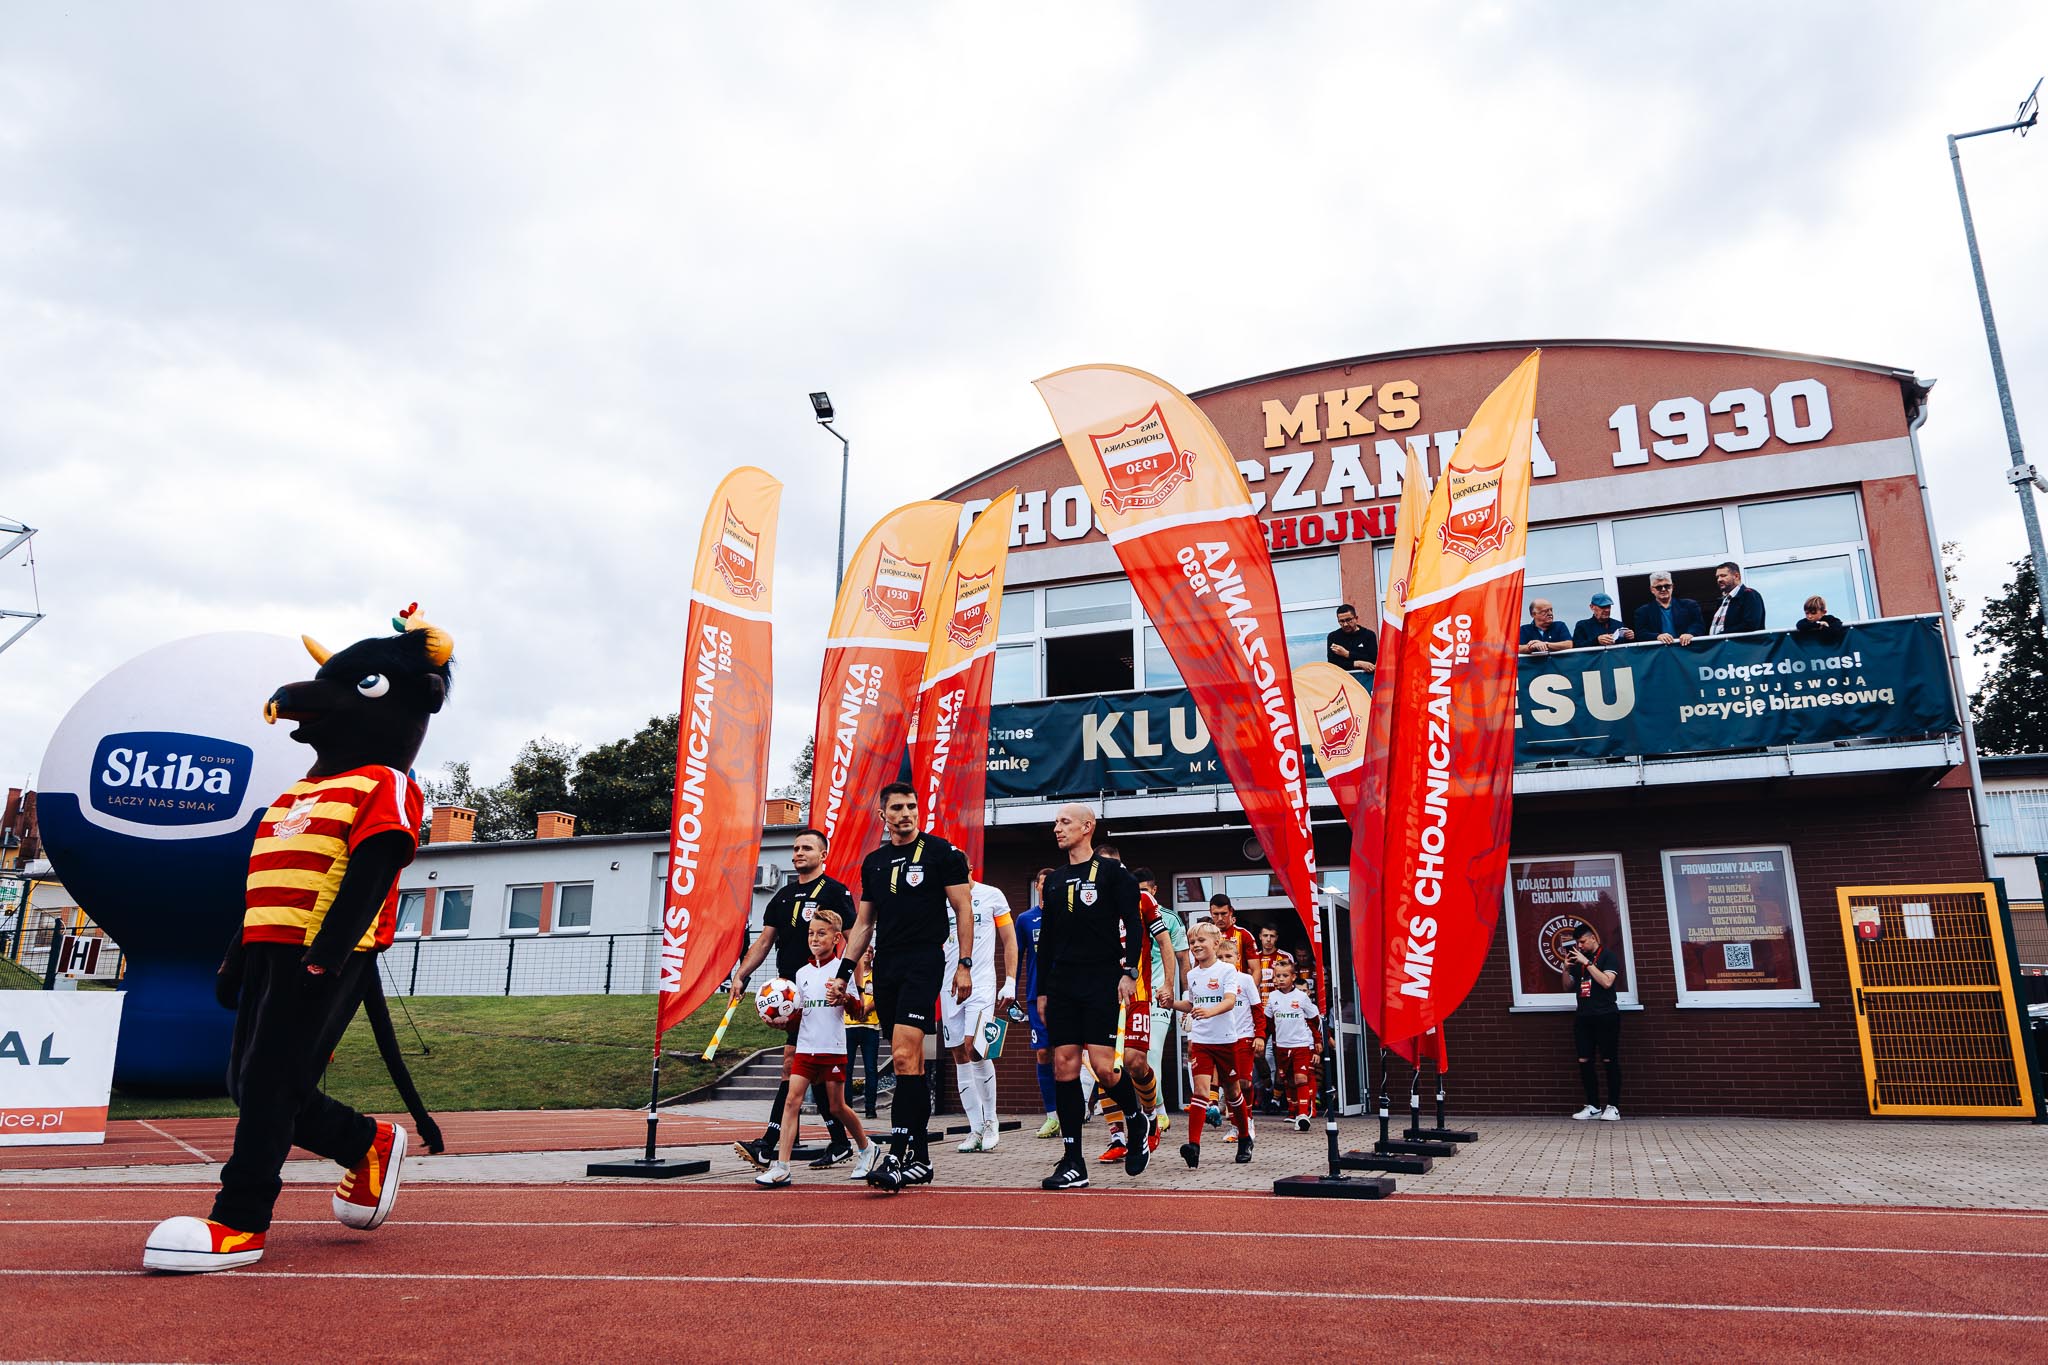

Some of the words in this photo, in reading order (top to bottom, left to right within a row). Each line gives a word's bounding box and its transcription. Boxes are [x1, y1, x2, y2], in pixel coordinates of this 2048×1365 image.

[1262, 379, 1421, 449] MKS
[1608, 378, 1833, 467] 1930
[1262, 504, 1397, 550] HOJNI
[1461, 509, 1490, 527] 1930
[729, 551, 746, 568] 1930
[882, 557, 897, 566] MKS
[880, 568, 922, 580] CHOJNICZANKA
[886, 589, 909, 600] 1930
[877, 611, 907, 627] CHOJNICE
[963, 606, 981, 621] 1930
[1455, 615, 1472, 664] 1930
[718, 630, 733, 673] 1930
[1699, 662, 1774, 682] Dołącz
[1777, 658, 1806, 675] do
[1811, 652, 1862, 671] nas!
[864, 665, 884, 707] 1930
[1718, 682, 1782, 697] BUDUJ
[1794, 676, 1867, 692] SWOJĄ
[1680, 696, 1766, 723] pozycję
[1770, 687, 1895, 712] biznesową
[1083, 707, 1211, 760] KLU
[200, 755, 214, 763] OD
[216, 756, 235, 764] 1991
[672, 624, 718, 895] CHOJNICZANKA
[822, 663, 869, 872] JNICZANKA
[1190, 760, 1216, 773] MK
[1415, 616, 1453, 906] CHOJNICZANKA
[102, 747, 232, 795] Skiba
[108, 796, 144, 807] ŁĄCZY
[149, 798, 174, 808] NAS
[178, 800, 216, 812] SMAK
[1681, 862, 1737, 875] PROWADZIMY
[1739, 861, 1775, 875] ZAJĘCIA
[1516, 878, 1550, 892] DOŁĄCZ
[1552, 877, 1566, 890] DO
[1567, 875, 1611, 889] AKADEMII
[1531, 889, 1599, 904] CHOJNICZANKI
[1546, 918, 1583, 937] AKADEM
[69, 940, 90, 971] H
[659, 905, 690, 993] MKS
[1401, 916, 1437, 999] MKS
[758, 994, 779, 1009] SELECT
[1132, 1013, 1150, 1033] 20
[1031, 1029, 1038, 1044] 9
